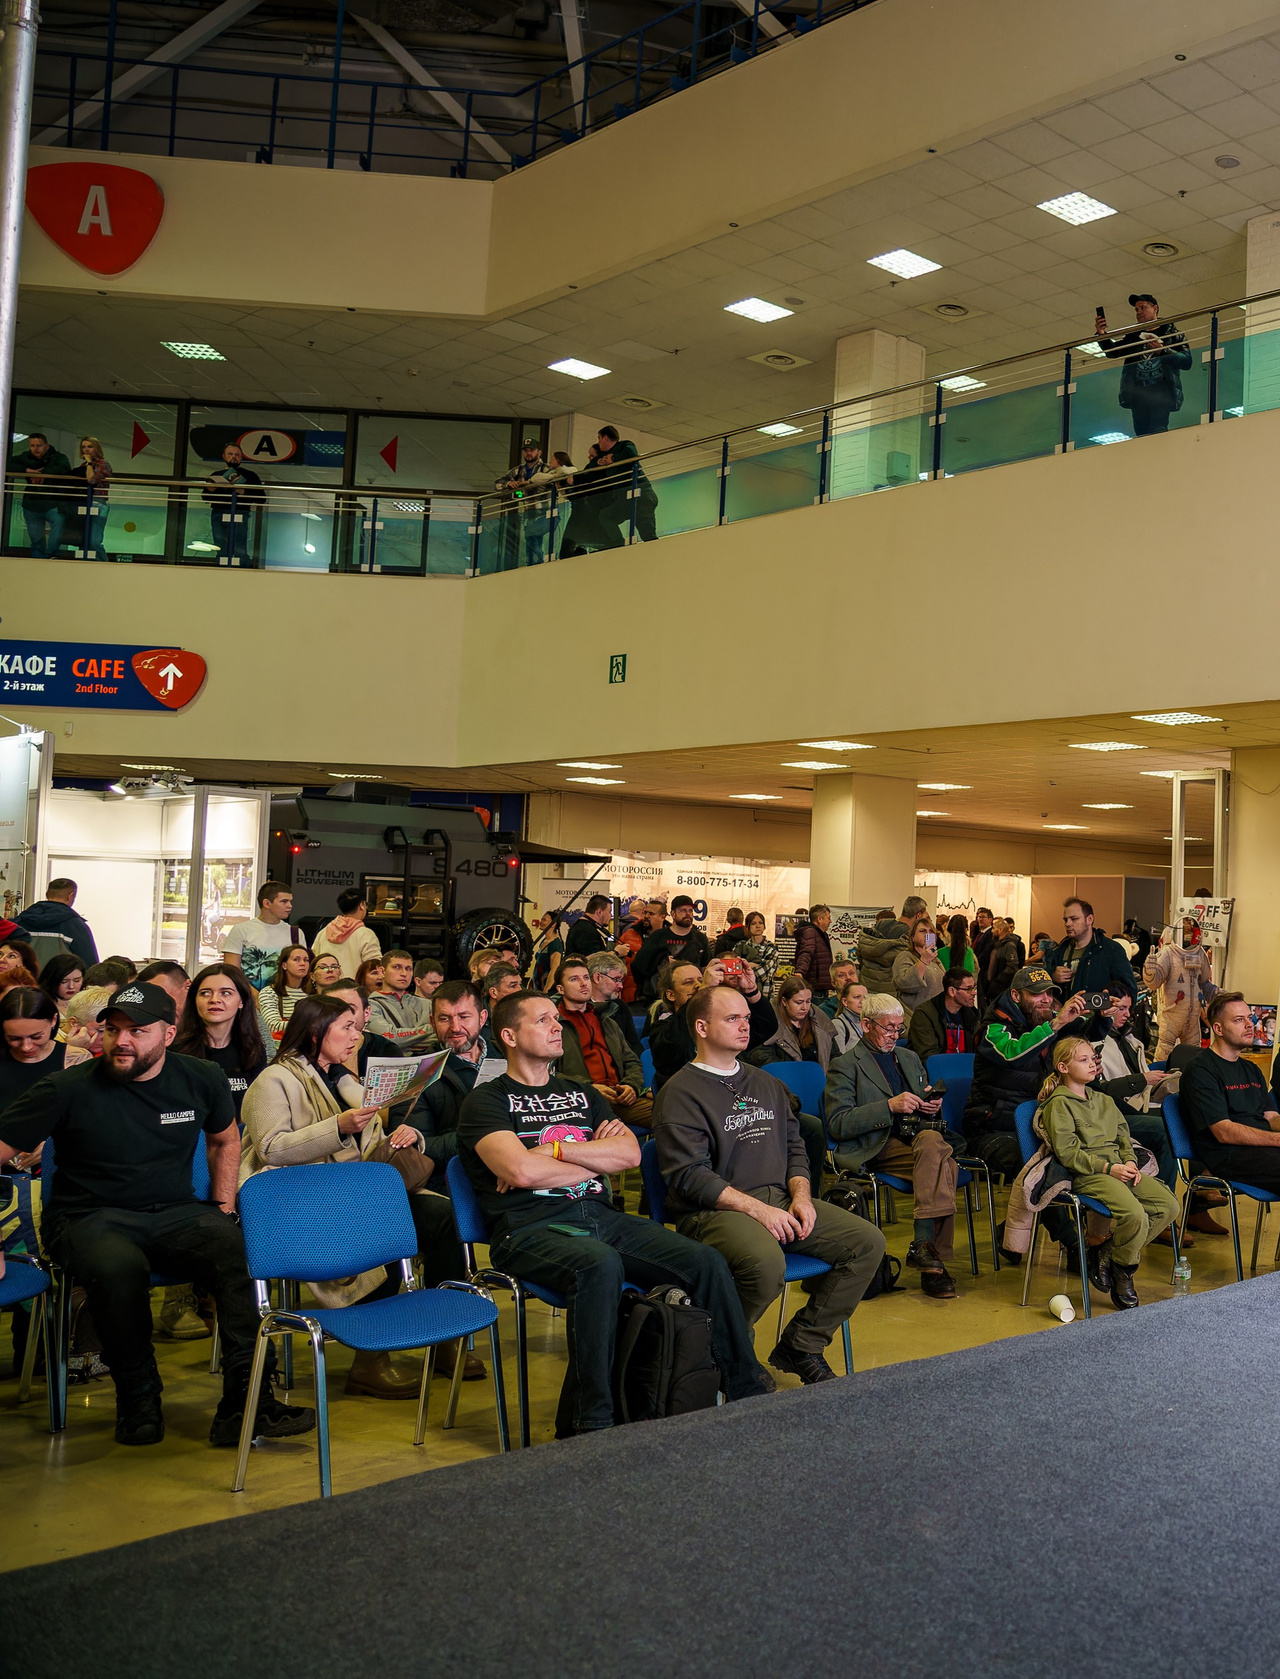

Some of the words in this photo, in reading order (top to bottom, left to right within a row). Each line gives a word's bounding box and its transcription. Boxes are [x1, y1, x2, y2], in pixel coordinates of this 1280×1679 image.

[0, 654, 57, 676] КАФЕ
[72, 659, 125, 679] CAFE
[3, 680, 19, 691] 2-й
[20, 682, 45, 692] этаж
[75, 684, 93, 694] 2nd
[94, 684, 118, 695] Floor
[296, 868, 355, 879] LITHIUM
[455, 859, 509, 878] 480
[603, 864, 663, 876] МОТОРОССИЯ
[296, 877, 355, 887] POWERED
[677, 875, 759, 889] 8-800-775-17-34
[1199, 921, 1220, 930] PEOPLE
[230, 1083, 248, 1092] AMPER
[507, 1090, 589, 1113] 反社会的
[176, 1110, 195, 1118] CAMPER
[521, 1114, 548, 1123] ANTI
[549, 1111, 587, 1123] SOCIAL
